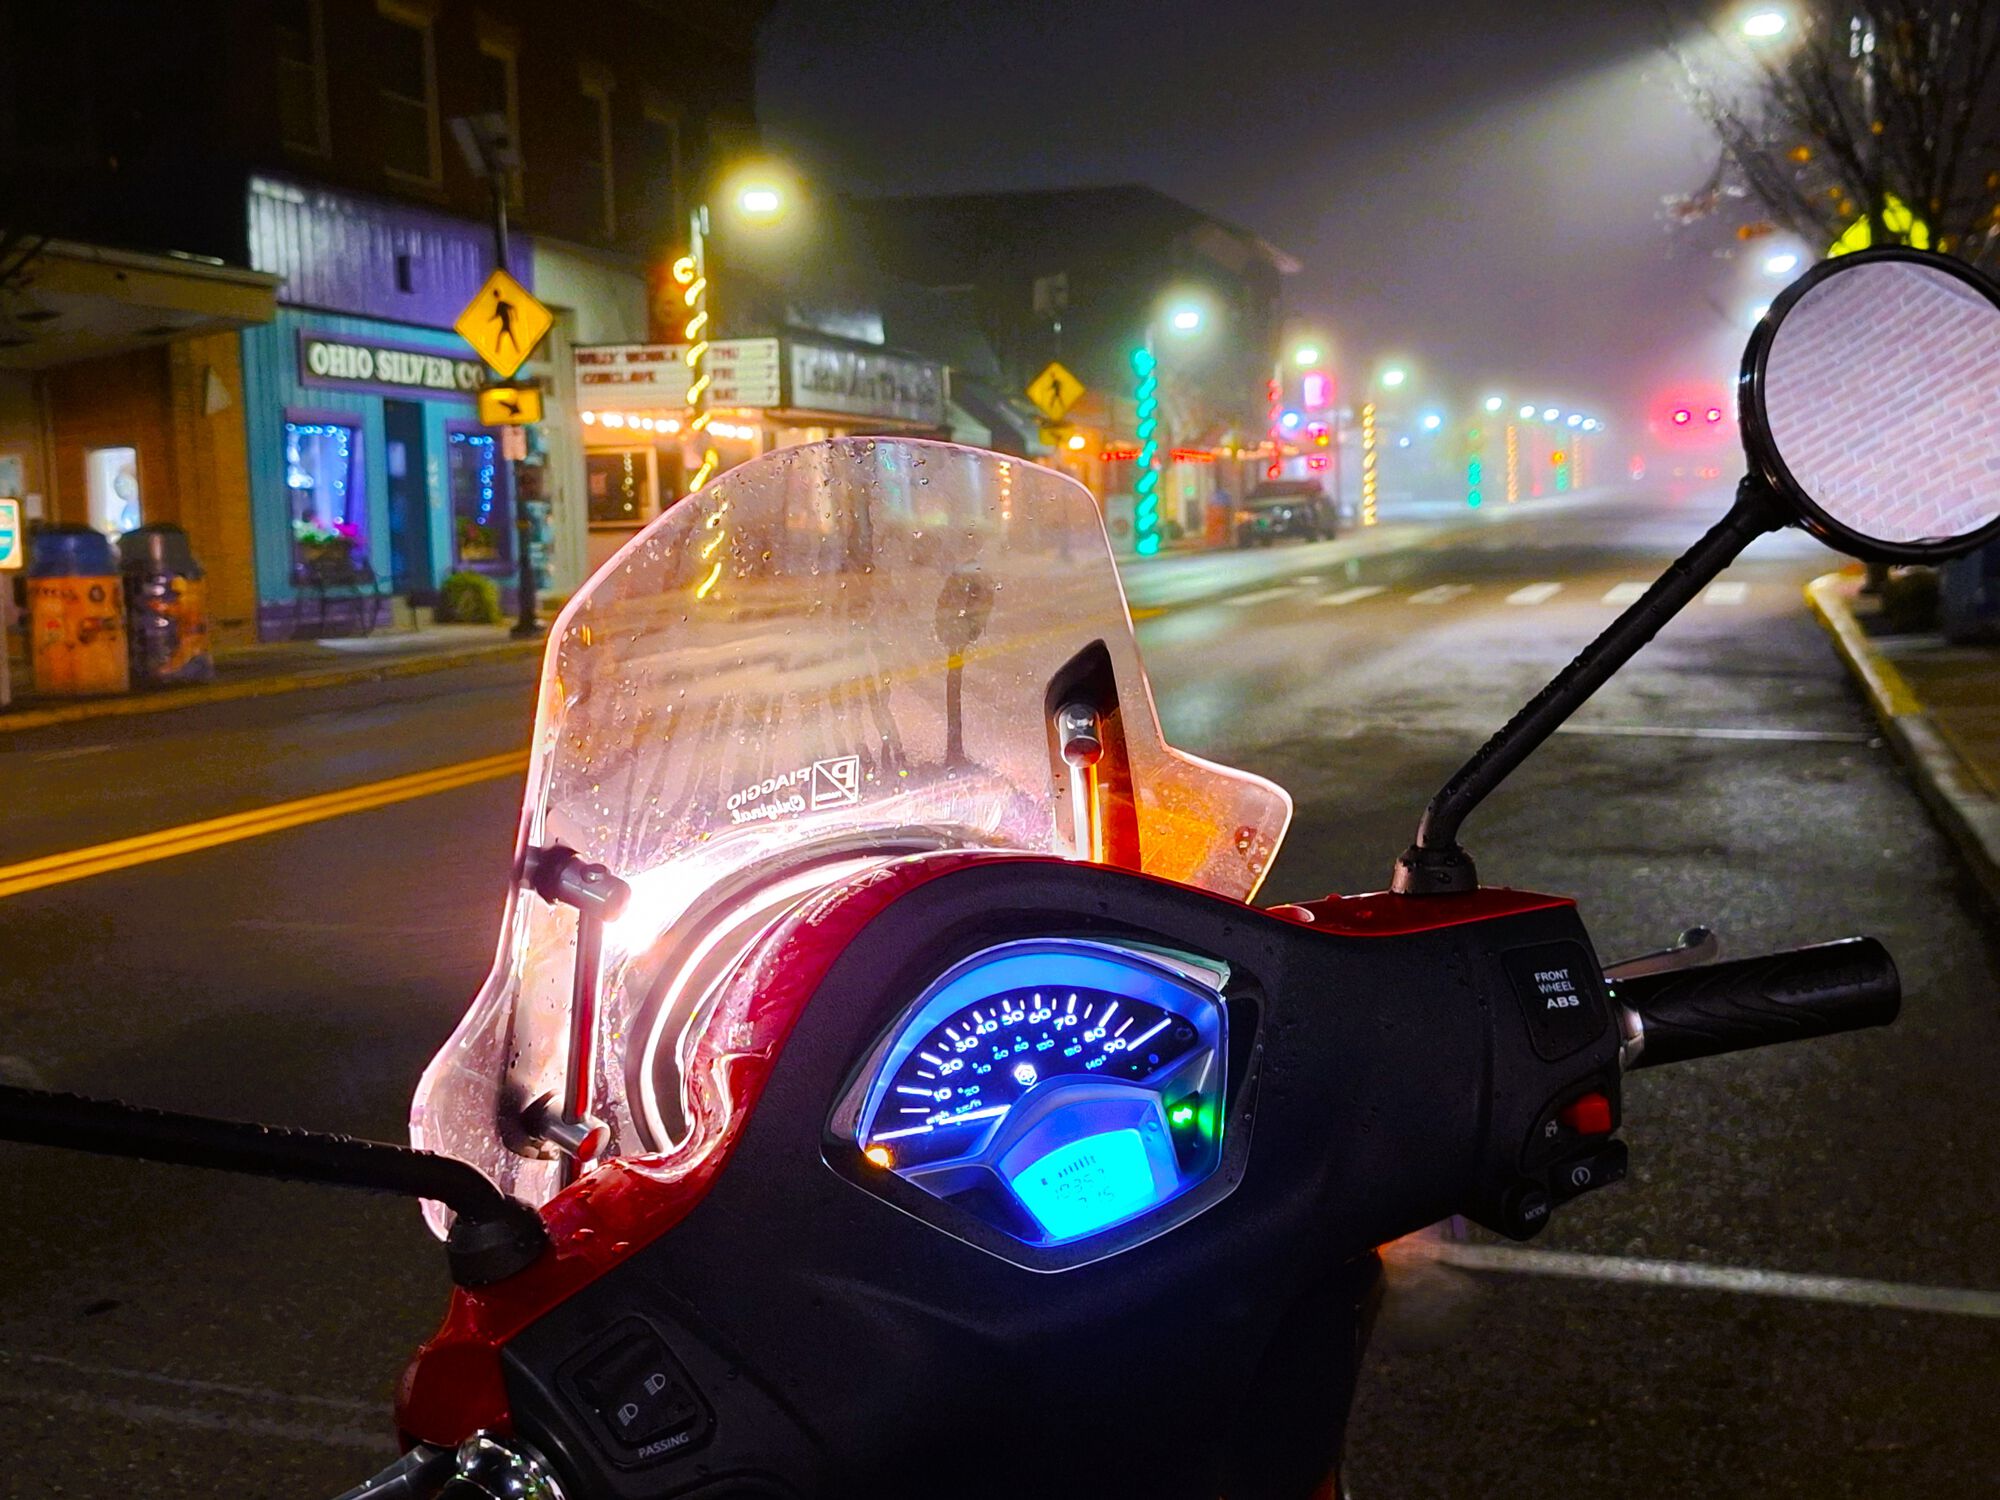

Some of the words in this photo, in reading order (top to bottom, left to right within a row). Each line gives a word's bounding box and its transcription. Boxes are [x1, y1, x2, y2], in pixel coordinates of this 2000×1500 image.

[308, 342, 374, 379] OHIO
[375, 350, 457, 389] SILVER
[1534, 968, 1569, 983] FRONT
[1538, 980, 1576, 994] WHEEL
[1546, 995, 1580, 1010] ABS
[1000, 1009, 1025, 1026] 50
[1028, 1007, 1052, 1024] 60
[1053, 1013, 1078, 1031] 70
[975, 1020, 999, 1035] 40
[1083, 1026, 1107, 1043] 80
[954, 1036, 979, 1053] 30
[1103, 1037, 1127, 1054] 90
[939, 1058, 964, 1076] 20
[964, 1085, 980, 1097] 20
[976, 1063, 992, 1075] 40
[993, 1049, 1009, 1061] 60
[933, 1086, 952, 1102] 10
[637, 1431, 690, 1459] PASSING
